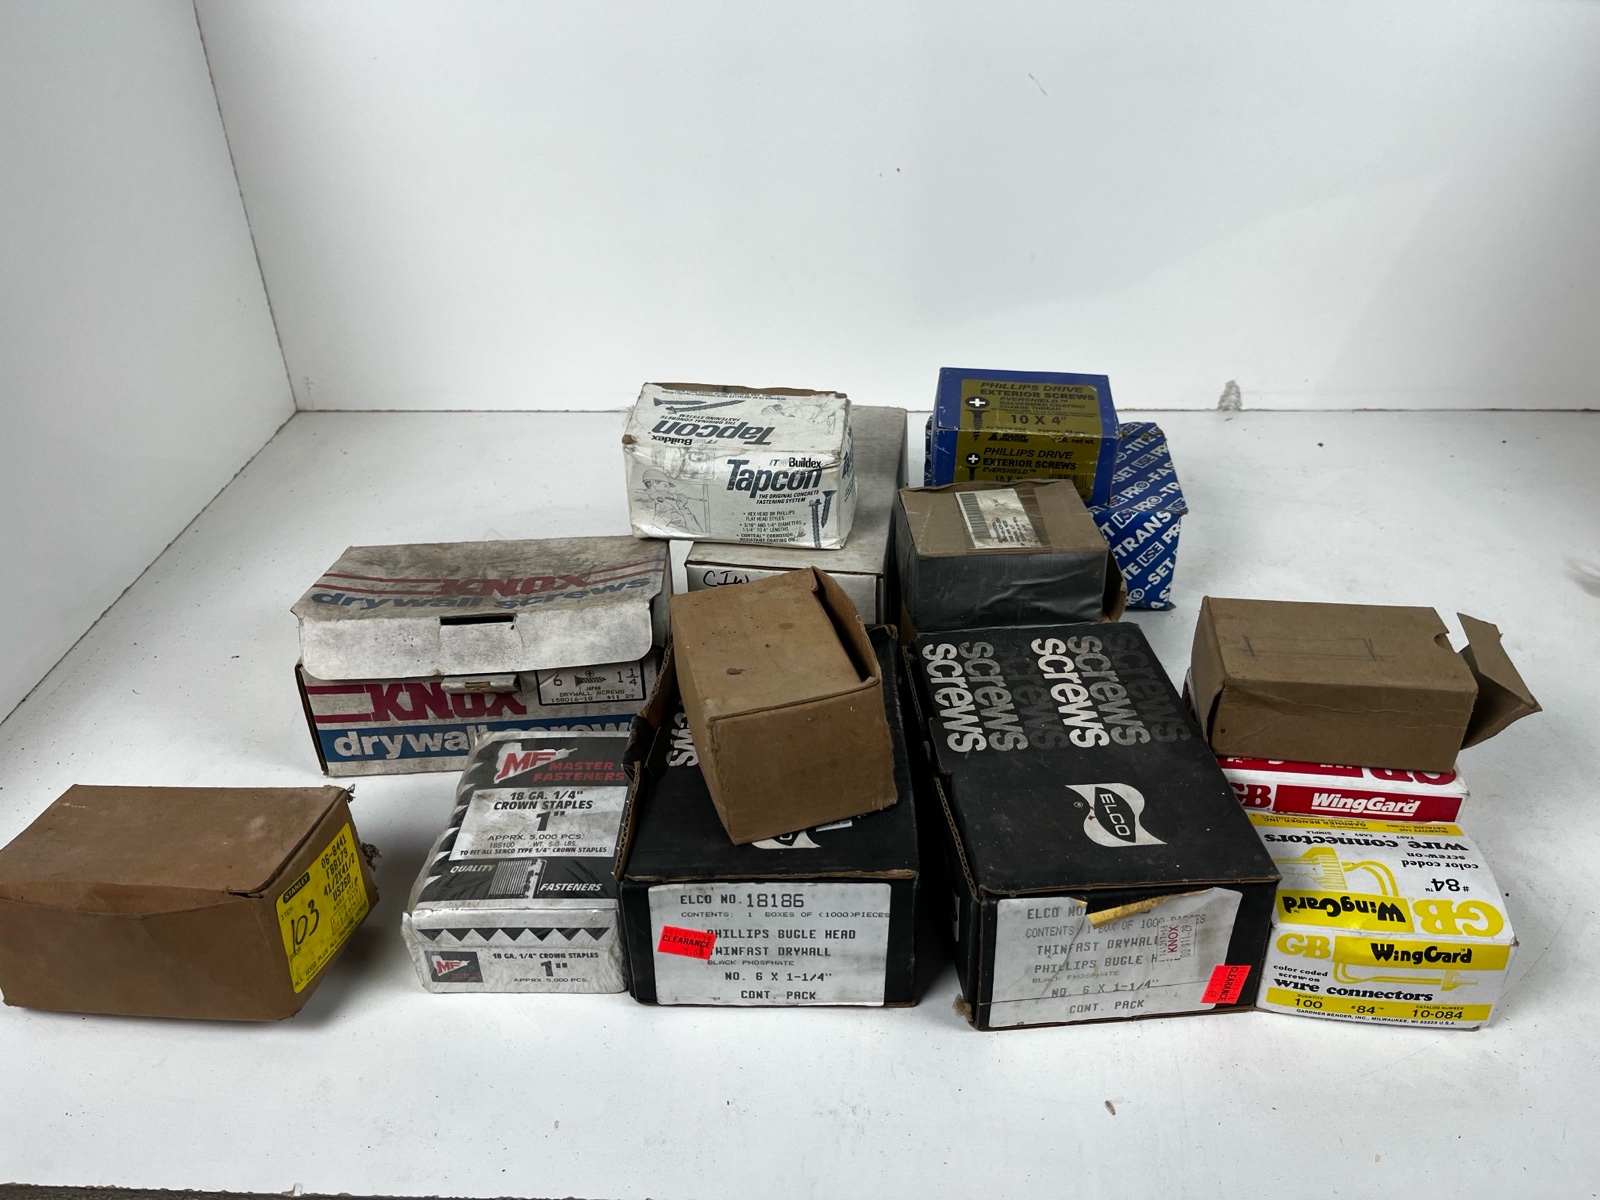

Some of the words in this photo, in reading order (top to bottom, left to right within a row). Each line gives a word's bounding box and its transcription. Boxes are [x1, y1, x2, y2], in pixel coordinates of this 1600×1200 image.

[980, 382, 1039, 392] PHILLIPS
[1043, 385, 1084, 393] DRIVE
[980, 389, 1040, 398] EXTERIOR
[1044, 392, 1096, 400] SCREWS
[1010, 414, 1028, 424] 10
[1034, 416, 1046, 425] X
[1051, 416, 1066, 426] 4"
[651, 434, 693, 445] Buildex
[652, 420, 775, 445] Tapcon
[984, 448, 1034, 458] PHILLIPS
[1038, 450, 1074, 460] DRIVE
[788, 457, 822, 468] Buildex
[983, 458, 1032, 468] EXTERIOR
[1035, 461, 1076, 470] SCREWS
[726, 459, 823, 498] Tapcon
[793, 490, 820, 498] CONCRETE
[1136, 541, 1165, 568] USE
[440, 573, 592, 597] KNOX
[310, 591, 486, 611] drywall
[494, 577, 651, 610] screws
[554, 674, 562, 686] 6
[922, 643, 986, 753] screws
[959, 641, 1028, 752] screws
[1030, 638, 1110, 748] screws
[1067, 636, 1150, 746] screws
[370, 681, 527, 722] KNOX
[496, 752, 557, 781] MF
[548, 762, 615, 771] MASTER
[532, 772, 625, 782] FASTENERS
[510, 792, 524, 800] 18
[528, 791, 548, 800] GA.
[554, 790, 584, 800] 1/4"
[494, 801, 538, 810] CROWN
[542, 800, 594, 810] STAPLES
[1312, 792, 1422, 816] WingGard
[536, 811, 566, 832] 1"
[1100, 793, 1130, 836] ELCO
[1264, 834, 1398, 848] connectors
[1408, 841, 1469, 851] wire
[321, 834, 347, 869] 06-8441
[482, 848, 493, 856] ALL
[1406, 852, 1466, 860] screw-on
[325, 847, 349, 880] FBB179
[450, 864, 496, 874] QUALITY
[1401, 860, 1441, 870] coded
[1444, 862, 1479, 870] color
[283, 873, 309, 902] STANLEY
[539, 884, 603, 892] FASTENERS
[680, 894, 712, 904] ELCO
[720, 894, 742, 904] NO.
[746, 894, 804, 908] 18186
[1027, 908, 1059, 920] ELCO
[1282, 896, 1406, 922] WingGard
[1413, 900, 1504, 937] GB
[290, 899, 320, 956] 103
[1121, 920, 1134, 932] OF
[778, 929, 816, 939] BUGLE
[825, 930, 856, 939] HEAD
[1168, 926, 1179, 953] KNOX
[662, 934, 711, 949] CLEARANCE
[1276, 933, 1332, 960] GB
[778, 947, 832, 957] DRYWALL
[1370, 942, 1472, 964] WingGard
[436, 960, 463, 975] MF
[540, 960, 568, 977] 1"
[1034, 960, 1096, 974] PHILLIPS
[1104, 955, 1144, 967] BUGLE
[1274, 964, 1296, 973] color
[1301, 967, 1328, 978] coded
[725, 972, 746, 981] NO.
[756, 972, 763, 981] 6
[771, 972, 778, 981] X
[786, 972, 832, 982] 1-1/4"
[1218, 966, 1239, 1002] CLEARANCE
[1278, 972, 1320, 983] screw-on
[741, 990, 776, 1000] CONT.
[786, 990, 816, 1000] PACK
[1052, 987, 1072, 998] NO.
[1082, 985, 1090, 994] 6
[1098, 984, 1105, 994] X
[1273, 978, 1320, 993] wire
[1326, 986, 1433, 1002] connectors
[1069, 1003, 1104, 1014] CONT.
[1114, 1000, 1144, 1010] PACK
[1294, 998, 1322, 1009] 100
[1351, 1005, 1376, 1014] #84
[1296, 1008, 1326, 1016] GARDNER
[1327, 1012, 1354, 1020] BENDER,
[1372, 1016, 1409, 1024] MILWAUKEE,
[1412, 1009, 1463, 1020] 10-084
